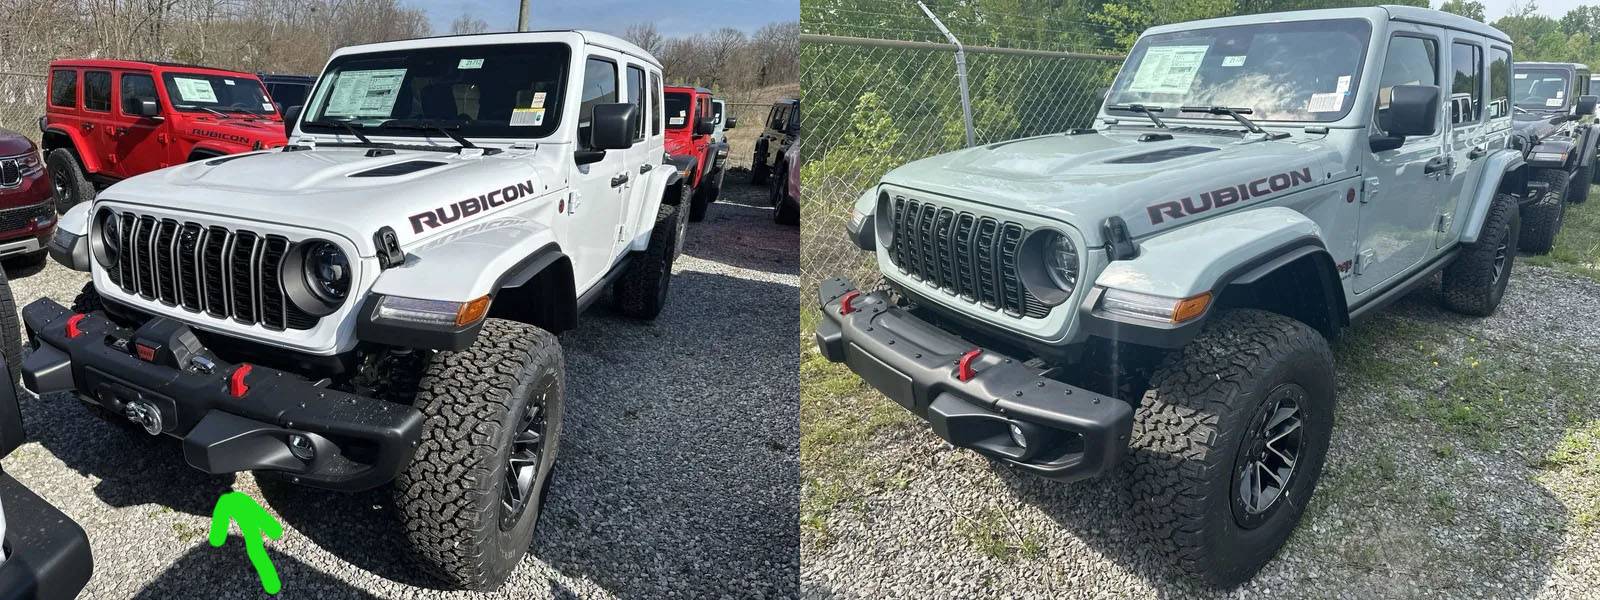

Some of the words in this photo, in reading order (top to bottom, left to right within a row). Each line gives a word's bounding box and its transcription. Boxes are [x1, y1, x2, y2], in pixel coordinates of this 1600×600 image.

[192, 128, 250, 144] RUBICON
[408, 180, 534, 235] RUBICON
[1146, 167, 1312, 225] RUBICON
